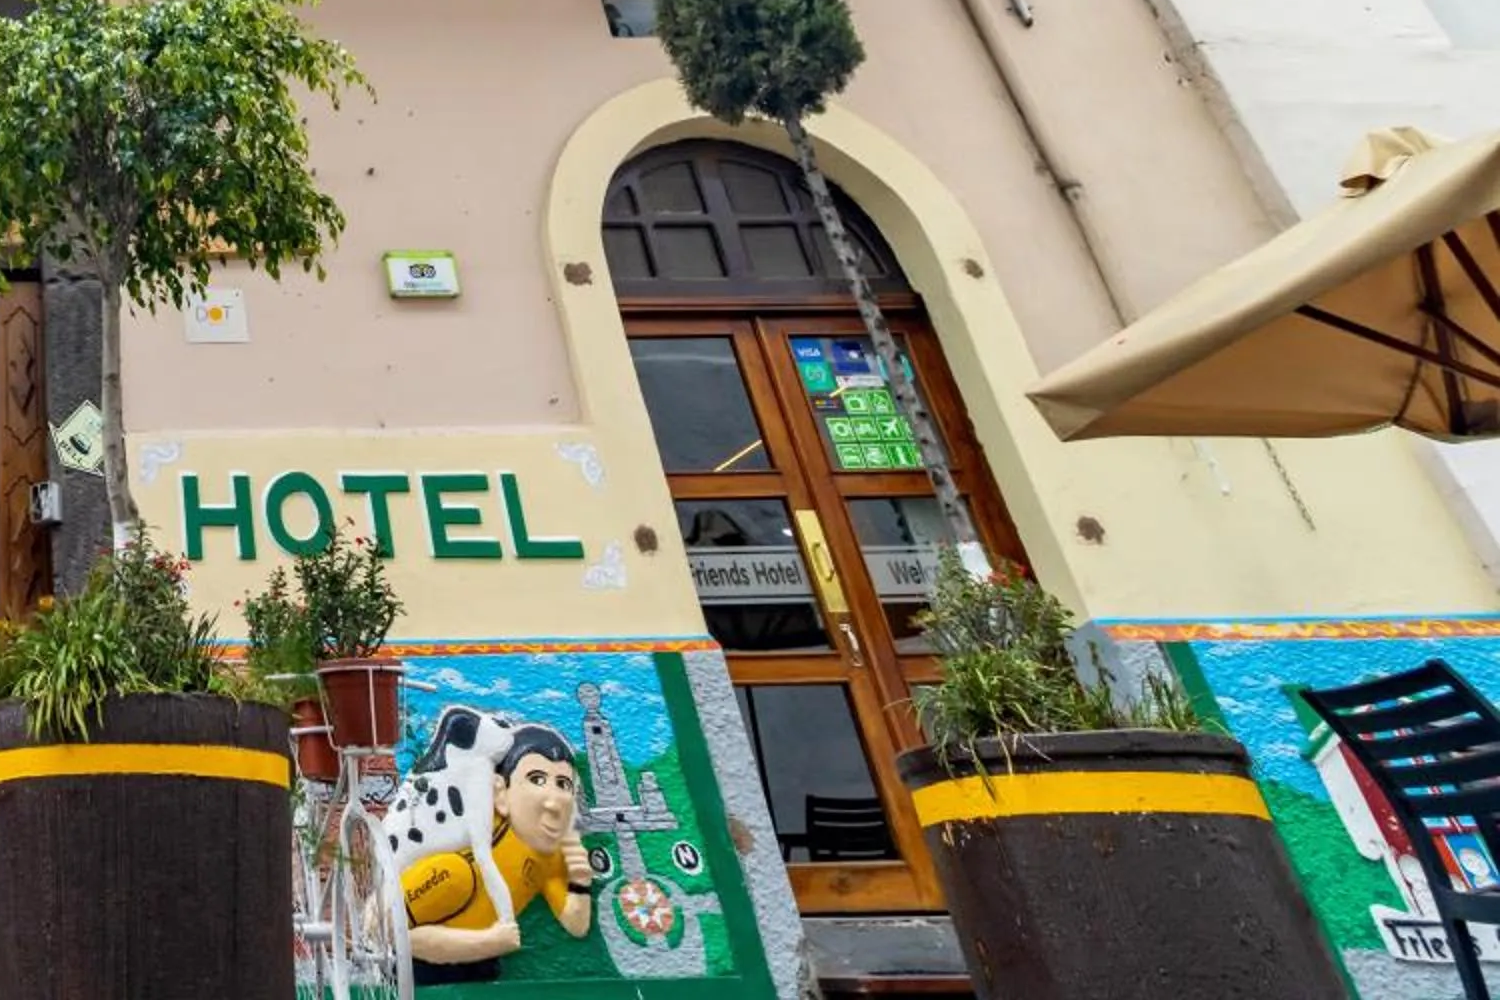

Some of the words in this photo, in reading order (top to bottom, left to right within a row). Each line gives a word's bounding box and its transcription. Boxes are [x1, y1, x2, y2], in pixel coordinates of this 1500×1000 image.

[180, 470, 587, 561] HOTEL
[689, 560, 751, 587] riends
[751, 559, 803, 585] Hotel
[1383, 920, 1483, 959] Fries
